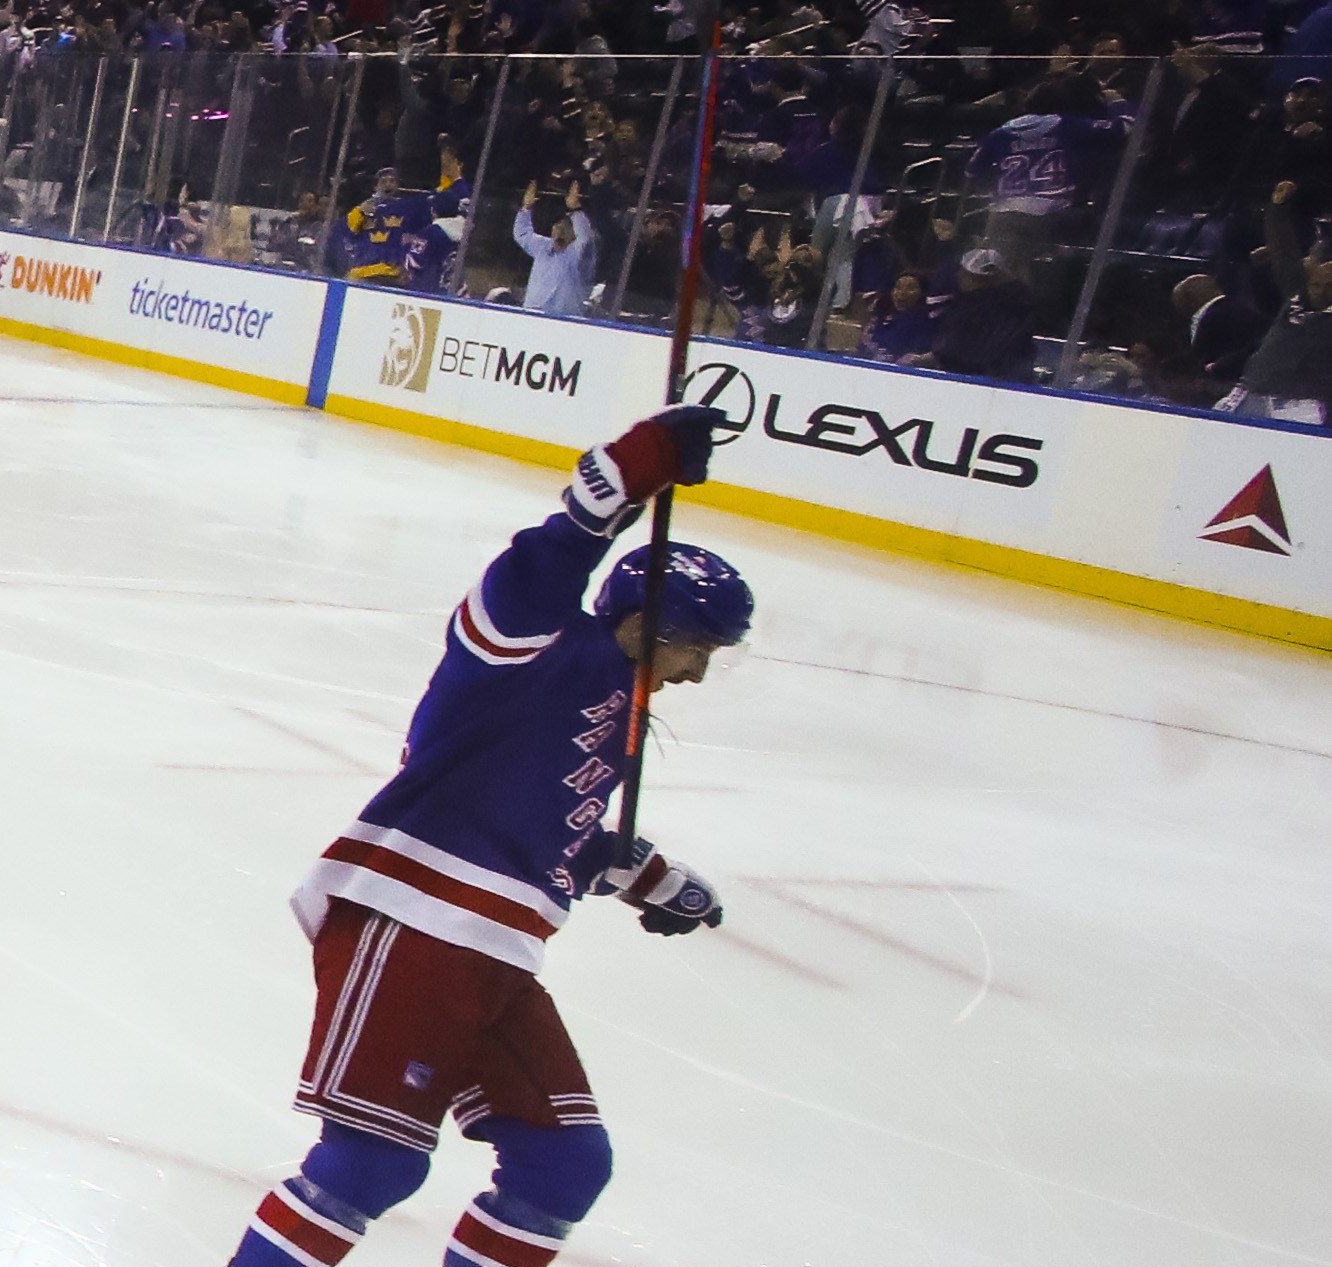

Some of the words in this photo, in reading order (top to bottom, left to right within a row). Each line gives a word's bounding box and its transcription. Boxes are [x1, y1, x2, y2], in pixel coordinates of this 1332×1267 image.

[998, 150, 1067, 196] 24
[12, 255, 102, 305] DUNKIN'
[130, 277, 274, 340] ticketmaster
[439, 336, 582, 397] BETMGM
[763, 393, 1044, 488] LEXUS
